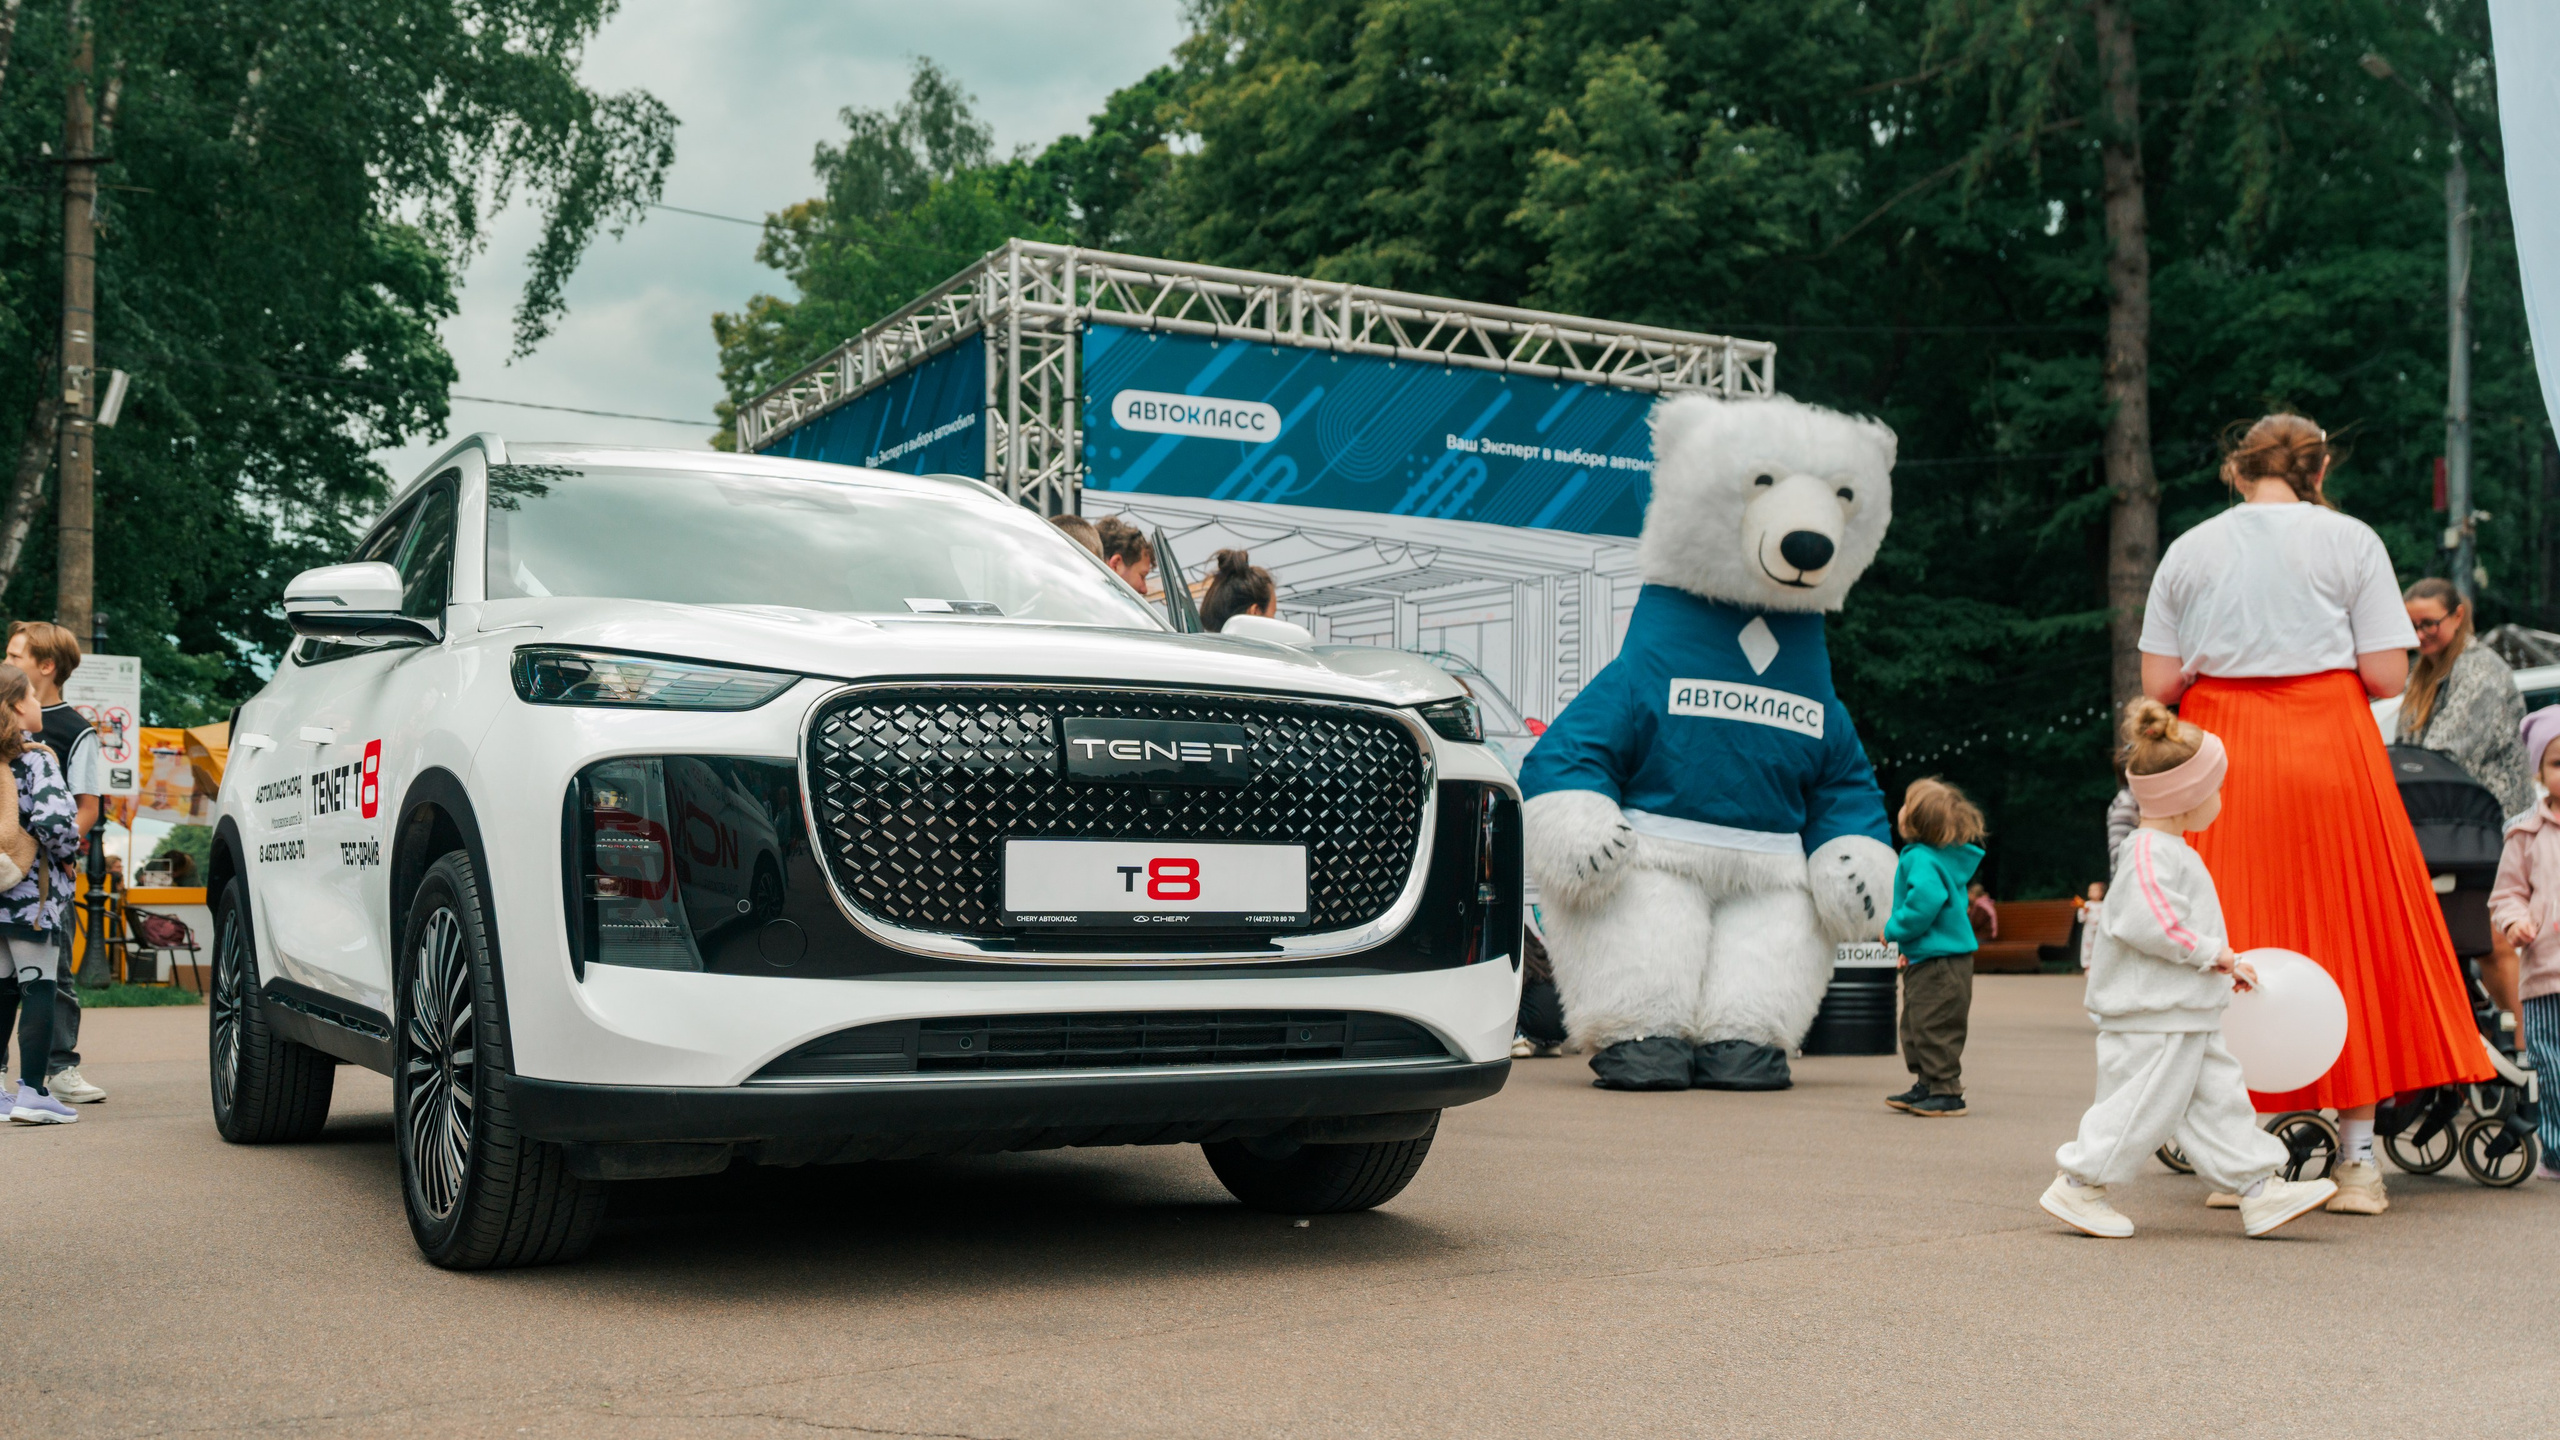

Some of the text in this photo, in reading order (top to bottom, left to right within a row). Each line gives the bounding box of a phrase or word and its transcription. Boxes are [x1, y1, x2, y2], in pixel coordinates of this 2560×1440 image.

[1129, 401, 1265, 430] АВТОКЛАСС
[866, 456, 879, 468] Ваш
[879, 443, 904, 464] Эксперт
[904, 442, 909, 453] в
[909, 431, 933, 451] выборе
[1446, 433, 1657, 472] Ваш Эксперт в выборе автомо
[1677, 688, 1818, 727] АВТОКЛАСС
[1072, 738, 1244, 763] TENET
[255, 775, 302, 803] АВТОКЛАСС НОРД
[312, 739, 382, 819] TENET T8
[259, 839, 305, 863] 8 4872 70-80-70
[340, 835, 379, 871] ТЕСТ-ДРАЙВ
[1253, 915, 1272, 923] (4872)
[1837, 948, 1898, 960] ВТОКЛАСС
